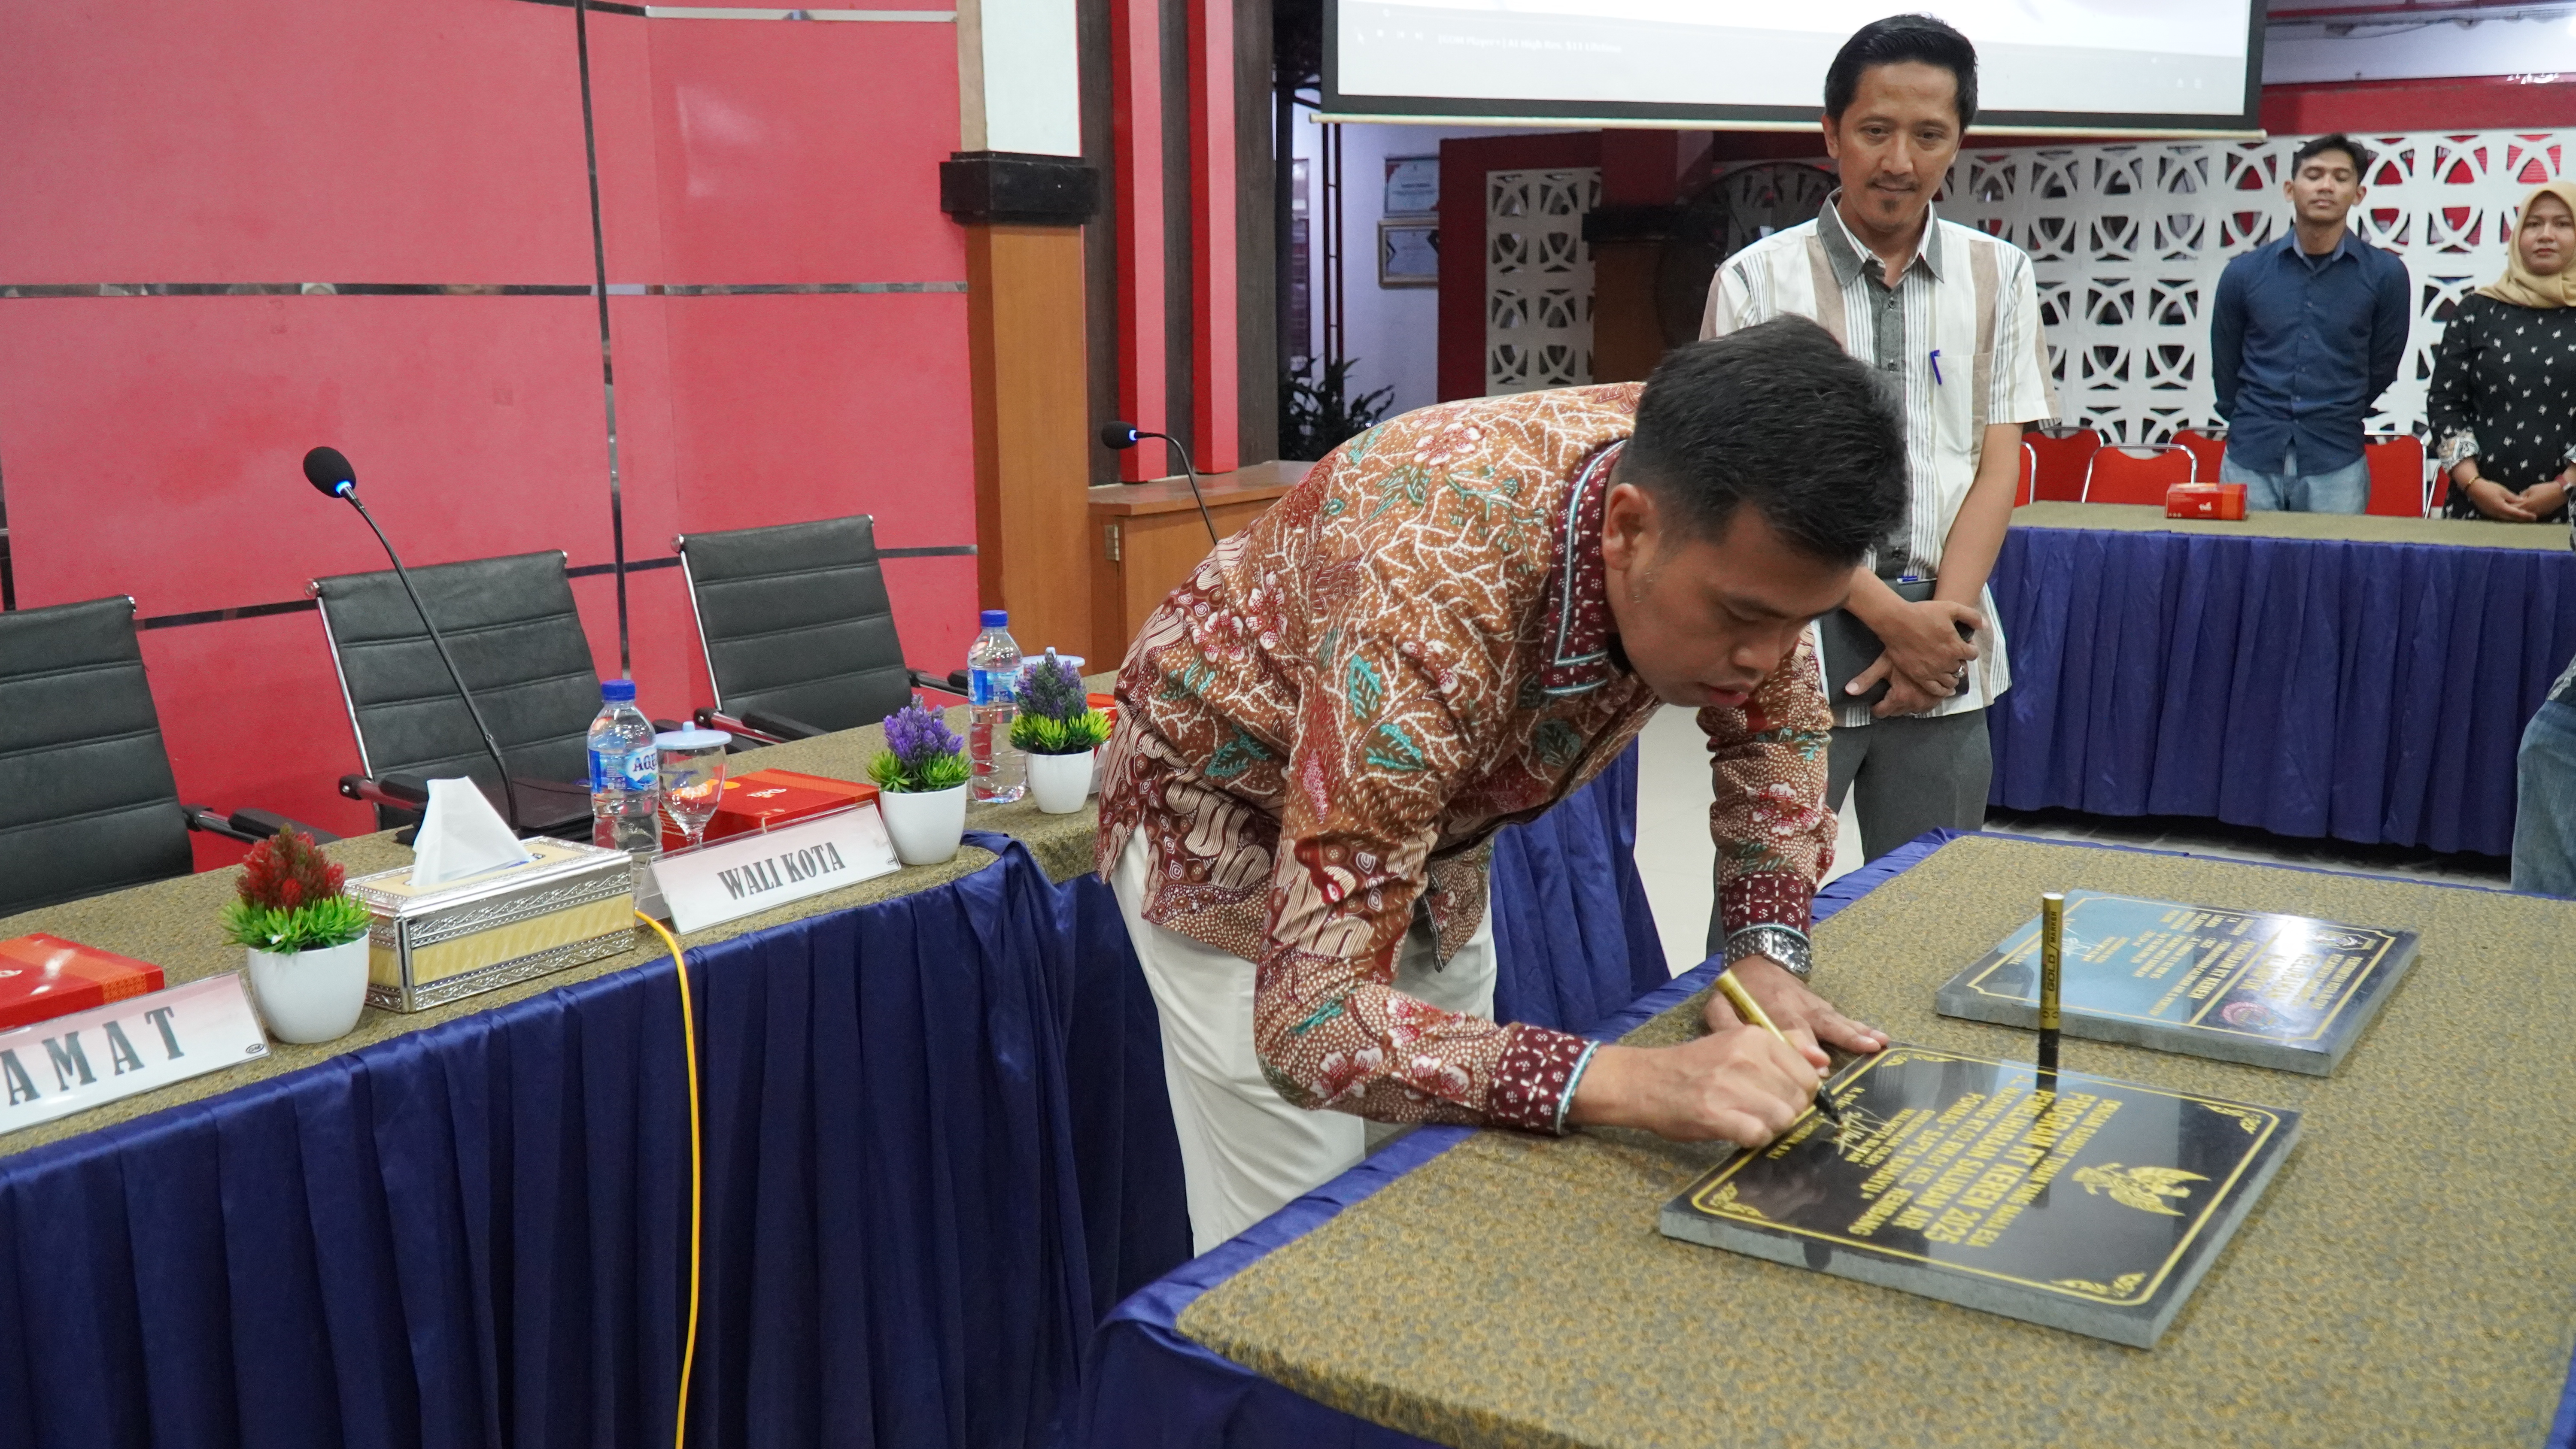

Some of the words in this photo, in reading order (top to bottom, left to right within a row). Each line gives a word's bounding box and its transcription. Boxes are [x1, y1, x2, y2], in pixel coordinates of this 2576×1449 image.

[717, 858, 783, 900] WALI
[780, 842, 846, 883] KOTA
[2216, 940, 2257, 969] PROGRAM
[2047, 954, 2056, 992] GOLD
[2186, 977, 2222, 999] KEREN
[2207, 968, 2230, 978] RT
[1933, 1092, 1987, 1125] POKMAS
[1971, 1086, 2026, 1120] WADANG
[2079, 1099, 2124, 1128] DENGAN
[1882, 1109, 1938, 1147] DIRESMIKAN
[1963, 1089, 2060, 1160] PEMELIHARAAN
[2017, 1091, 2100, 1148] PROGRAM
[1860, 1146, 1896, 1166] OLEH
[1898, 1129, 1947, 1157] SAPTA
[1999, 1145, 2047, 1165] RT
[2050, 1126, 2099, 1157] RAHMAT
[1856, 1155, 1918, 1193] RAHAYU
[1911, 1158, 1987, 1209] SALURAN
[2025, 1155, 2070, 1183] TUHAN
[1954, 1162, 2029, 1210] KEREN
[2003, 1181, 2046, 1206] YANG
[1843, 1187, 1918, 1237] REMBANG
[1888, 1206, 1938, 1231] AIR
[1918, 1206, 1986, 1246] 2025
[1980, 1203, 2025, 1230] MAHA
[1962, 1228, 2002, 1249] ESA
